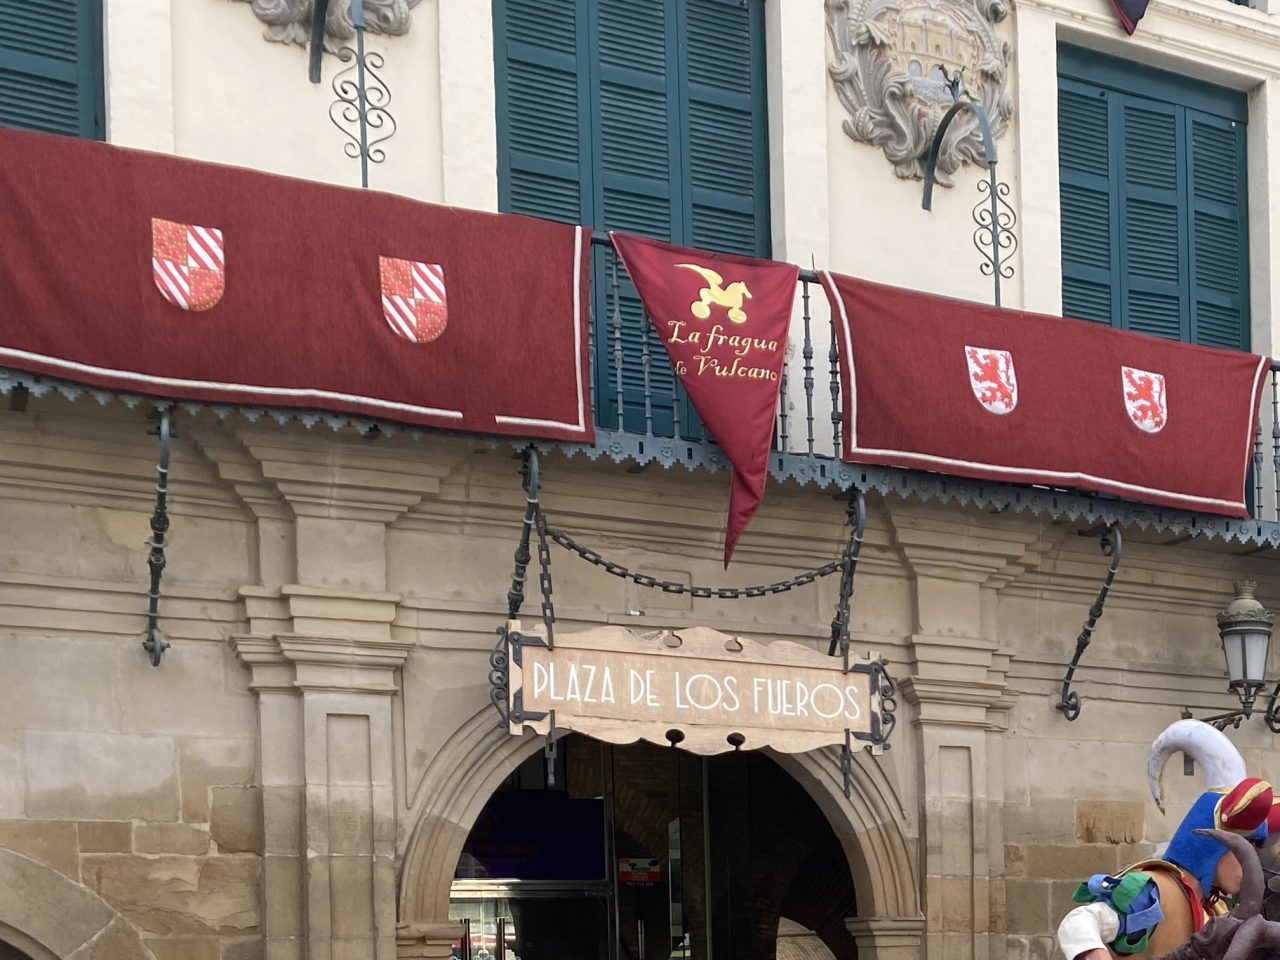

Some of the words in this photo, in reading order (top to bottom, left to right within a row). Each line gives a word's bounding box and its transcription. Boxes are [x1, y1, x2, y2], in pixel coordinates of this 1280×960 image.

[667, 320, 700, 344] La
[700, 324, 778, 355] fragua
[692, 355, 778, 382] Vulcano
[532, 661, 615, 704] PLAZA
[629, 668, 661, 708] DE
[674, 671, 741, 713] LOS
[753, 677, 862, 720] FUEROS
